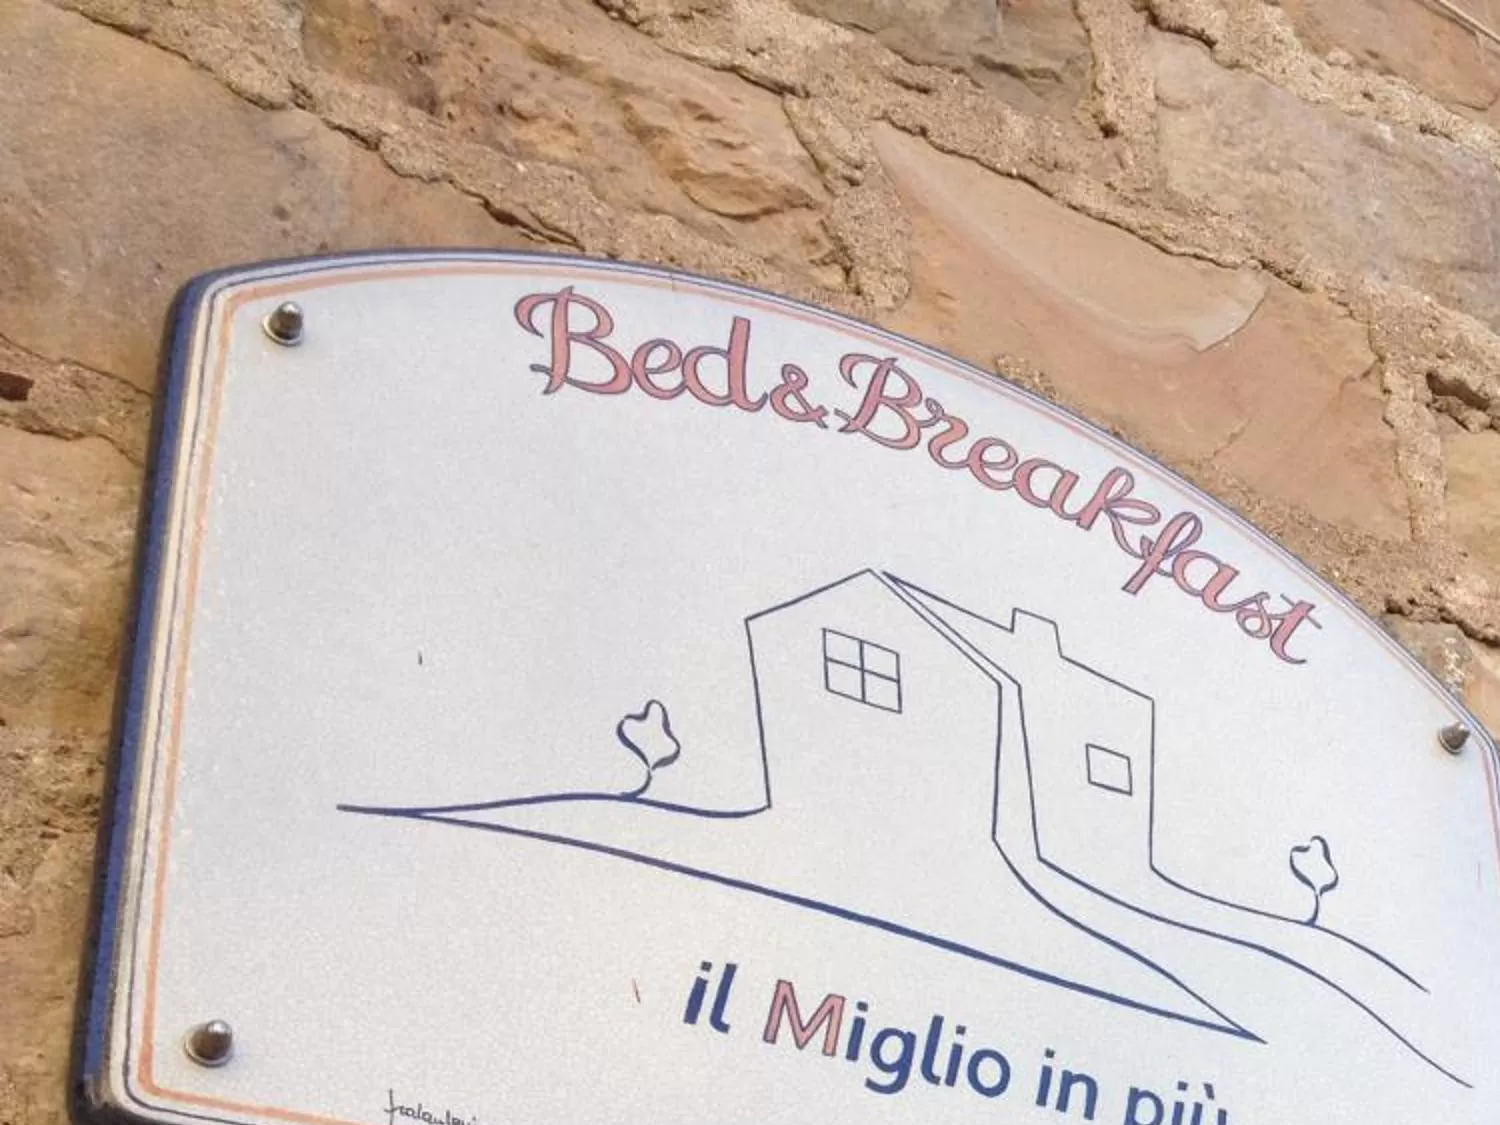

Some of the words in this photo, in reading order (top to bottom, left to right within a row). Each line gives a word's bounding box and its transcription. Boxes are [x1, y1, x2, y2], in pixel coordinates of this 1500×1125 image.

[682, 961, 738, 1034] il
[762, 979, 1012, 1098] Miglio
[1035, 1048, 1100, 1121] in
